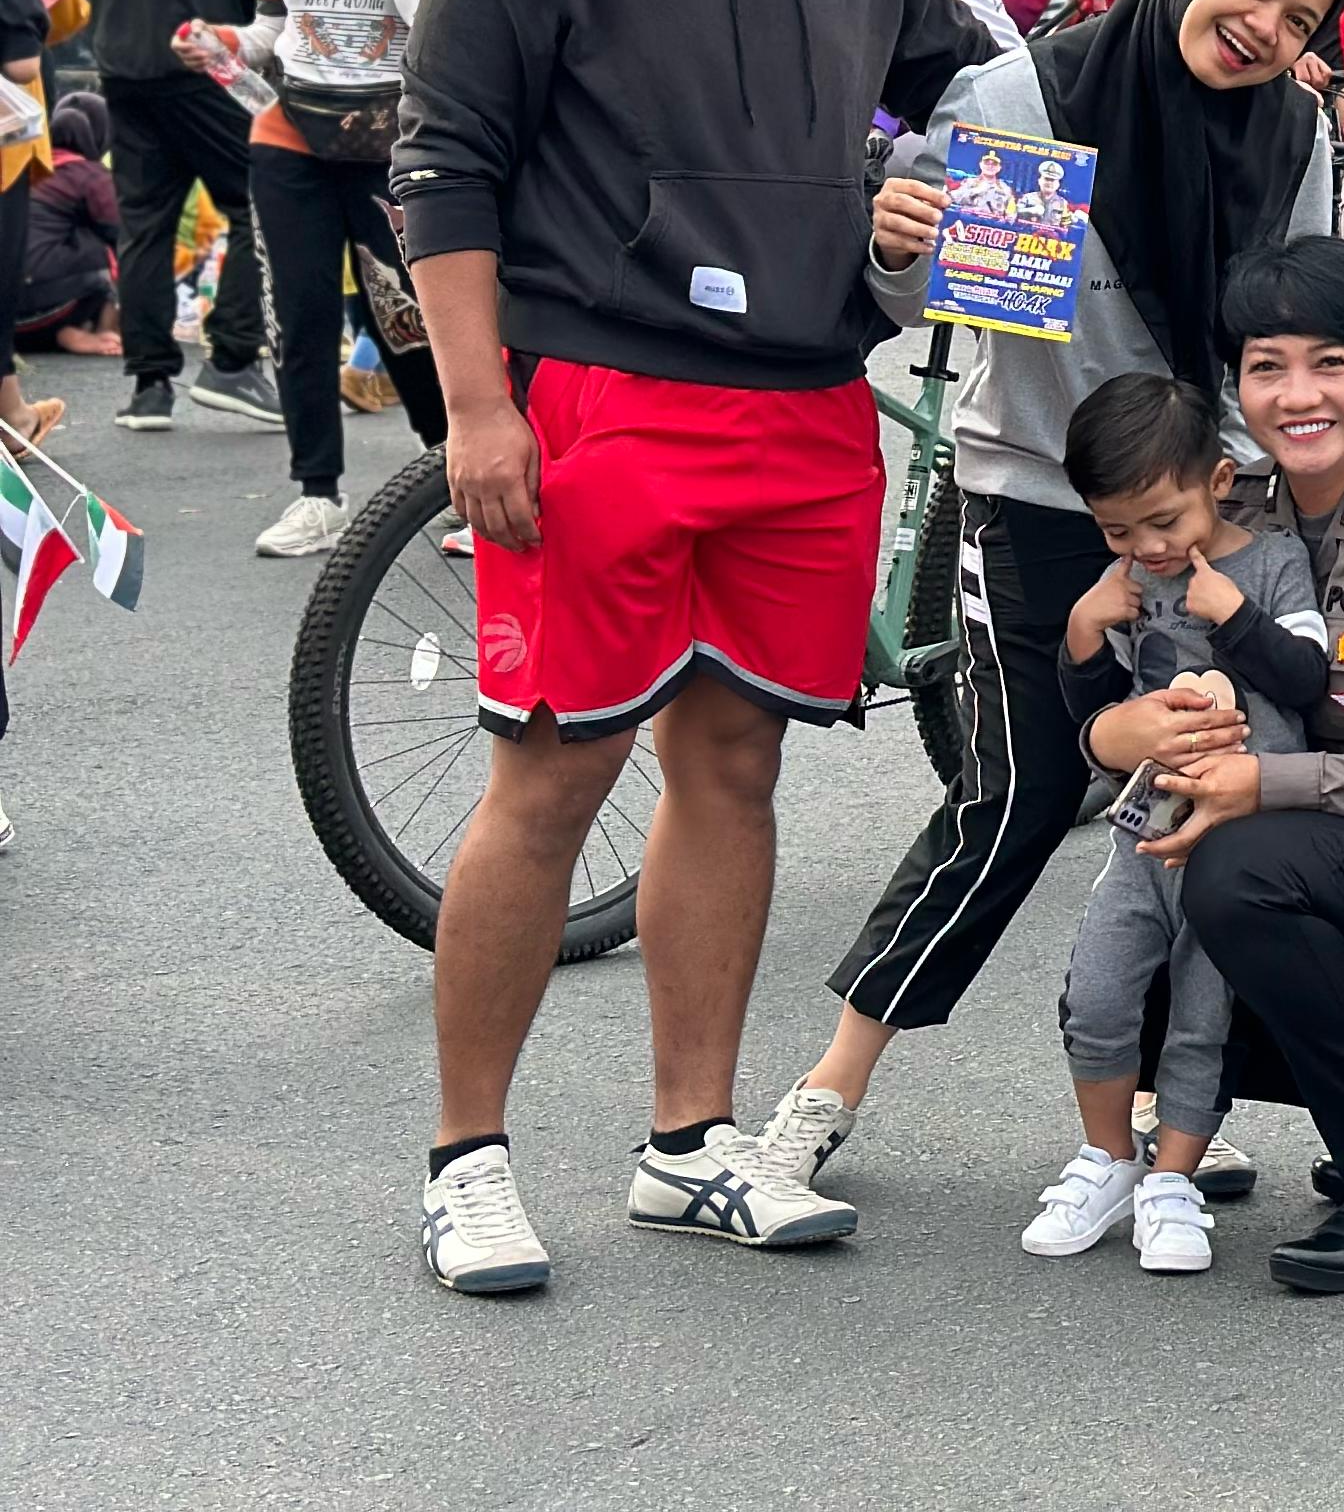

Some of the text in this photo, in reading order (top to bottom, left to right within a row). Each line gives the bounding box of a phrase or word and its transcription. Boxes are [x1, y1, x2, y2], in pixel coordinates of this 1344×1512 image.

[964, 224, 1017, 248] STOP
[1014, 233, 1076, 261] HOAX
[1010, 254, 1052, 271] AMAN
[1008, 267, 1073, 288] DAN DAMAI
[998, 290, 1053, 315] HOAX
